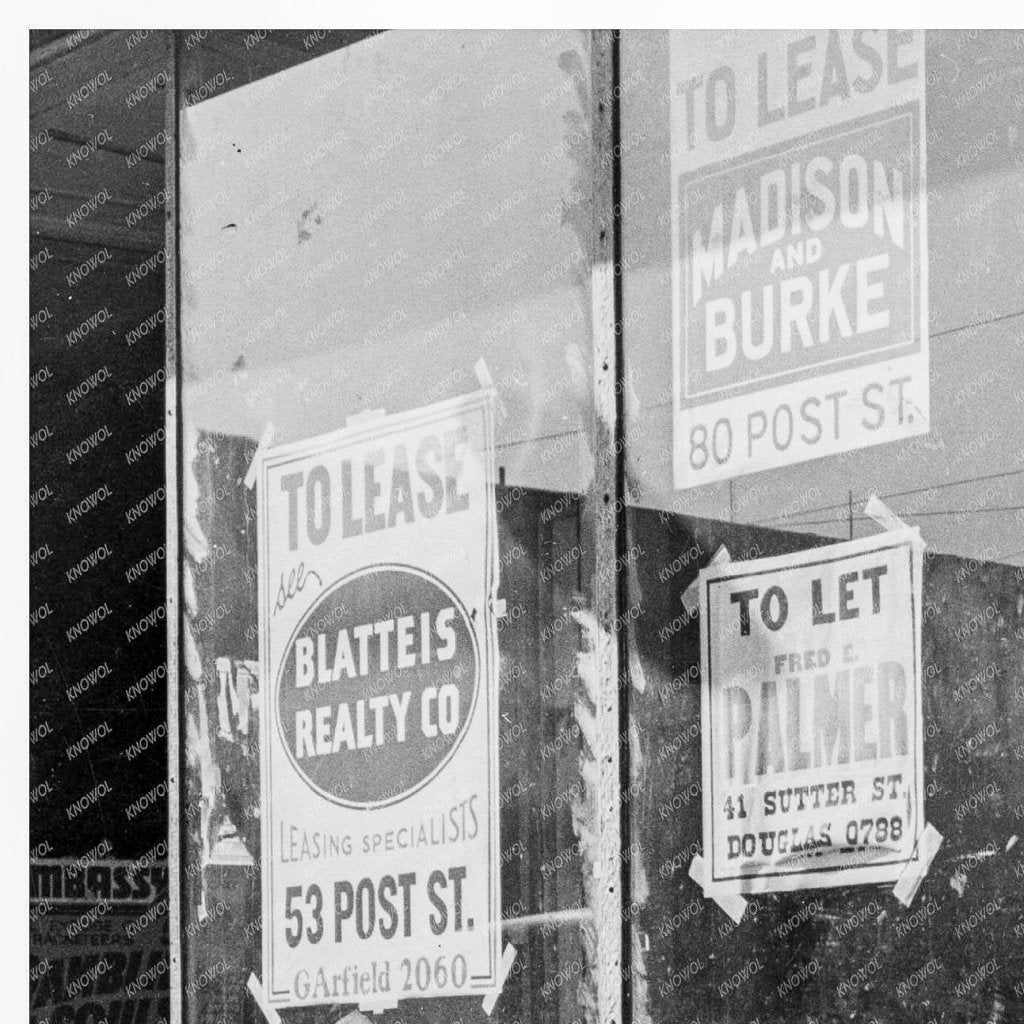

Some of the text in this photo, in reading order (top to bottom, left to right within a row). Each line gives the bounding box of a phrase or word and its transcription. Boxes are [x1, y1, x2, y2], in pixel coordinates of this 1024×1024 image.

[675, 28, 919, 151] TO LEASE
[693, 154, 904, 307] MADISON
[770, 237, 822, 273] AND
[705, 253, 890, 372] BURKE
[689, 376, 915, 471] 80 POST ST.
[281, 424, 469, 551] TO LEASE
[730, 565, 888, 636] TO LET
[295, 607, 457, 688] BLATTEIS
[774, 648, 831, 674] FRED
[295, 684, 460, 759] REALTY CO
[723, 660, 909, 781] PALMER
[280, 794, 479, 863] LEASING SPECIALISTS
[723, 773, 907, 820] 41 SUTTER ST.
[726, 815, 903, 861] DOUGLAS 0788
[285, 866, 475, 949] 53 POST ST.
[294, 954, 467, 1000] GArfield 2060
